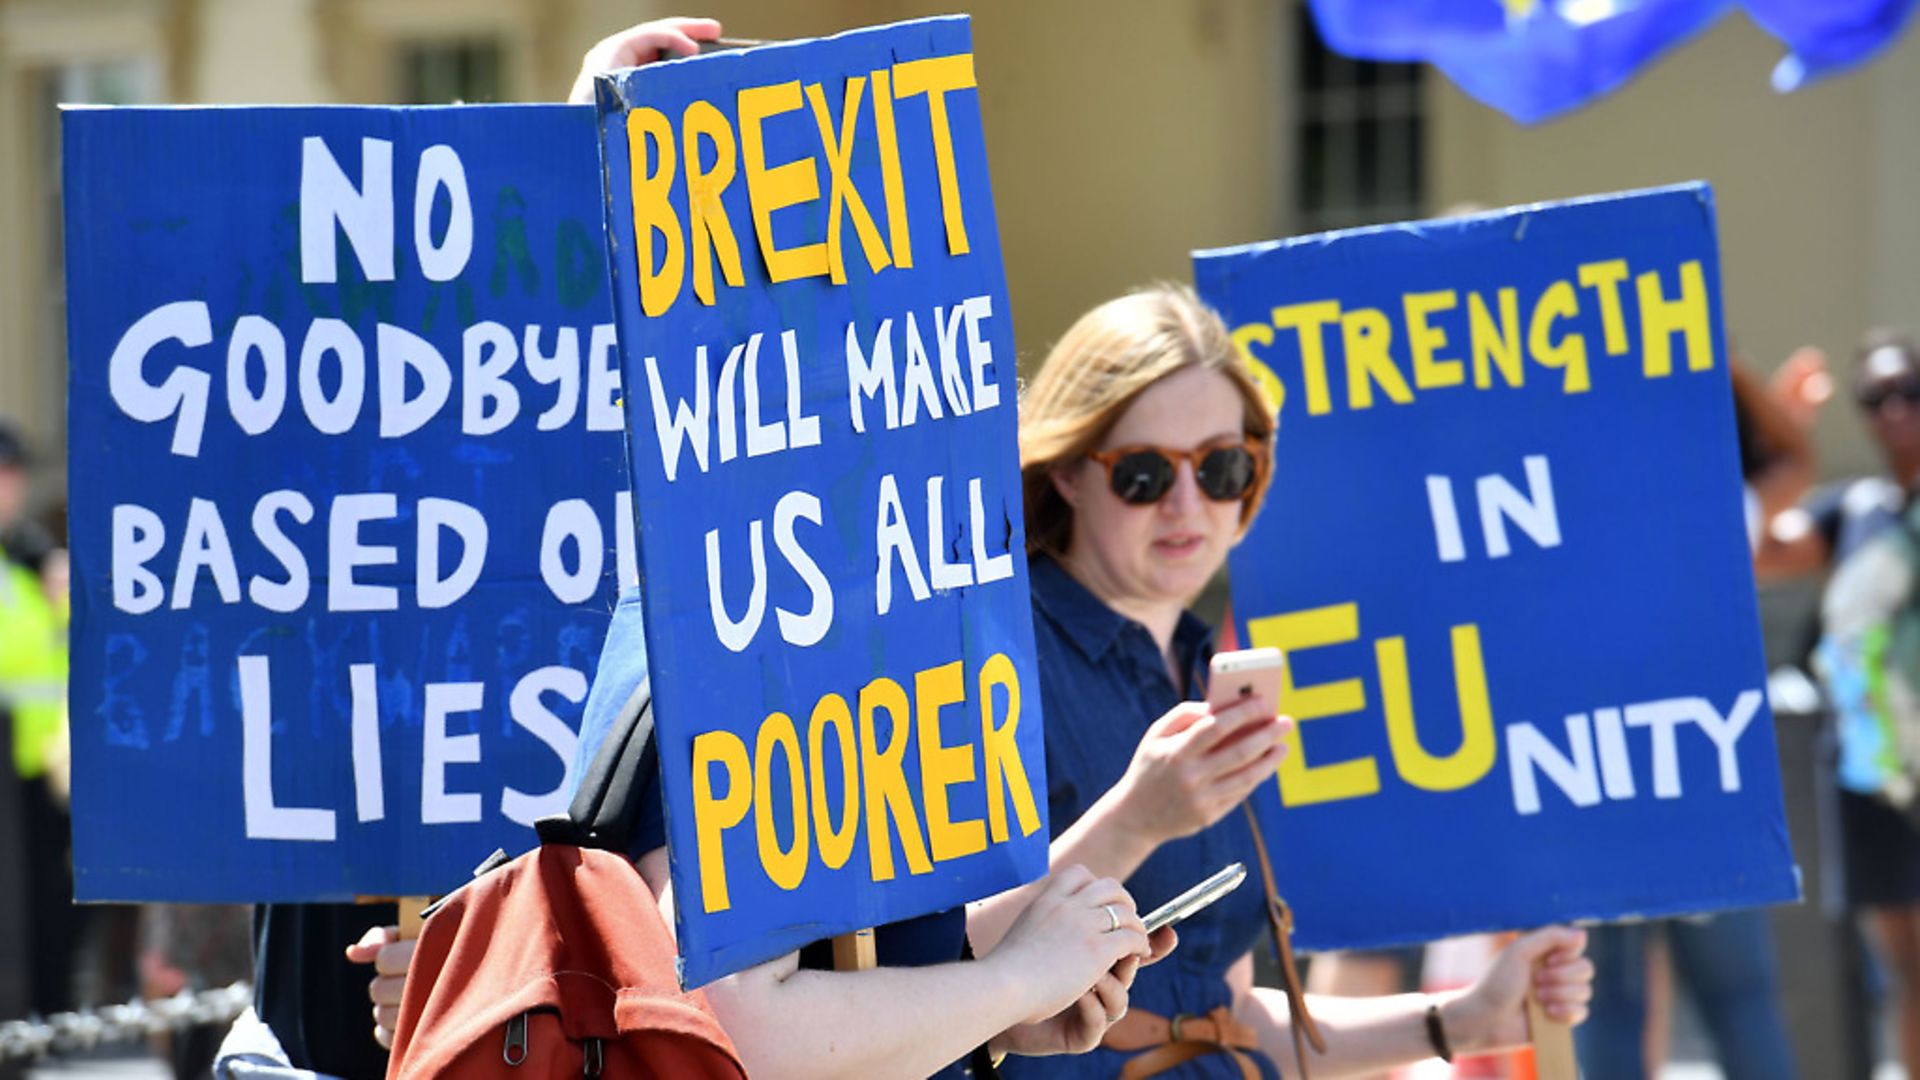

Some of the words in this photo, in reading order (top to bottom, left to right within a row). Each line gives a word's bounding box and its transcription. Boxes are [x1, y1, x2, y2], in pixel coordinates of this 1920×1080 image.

[300, 136, 473, 284] NO
[626, 53, 979, 318] BREXIT
[109, 301, 625, 458] GOODBYE
[644, 329, 822, 482] WILL
[846, 295, 1001, 434] MAKE
[1230, 259, 1714, 416] STRENGTH
[113, 490, 488, 614] BASED
[705, 490, 835, 652] US
[876, 474, 1015, 615] ALL
[1426, 455, 1563, 563] IN
[238, 655, 588, 841] LIES
[692, 653, 1042, 913] POORER
